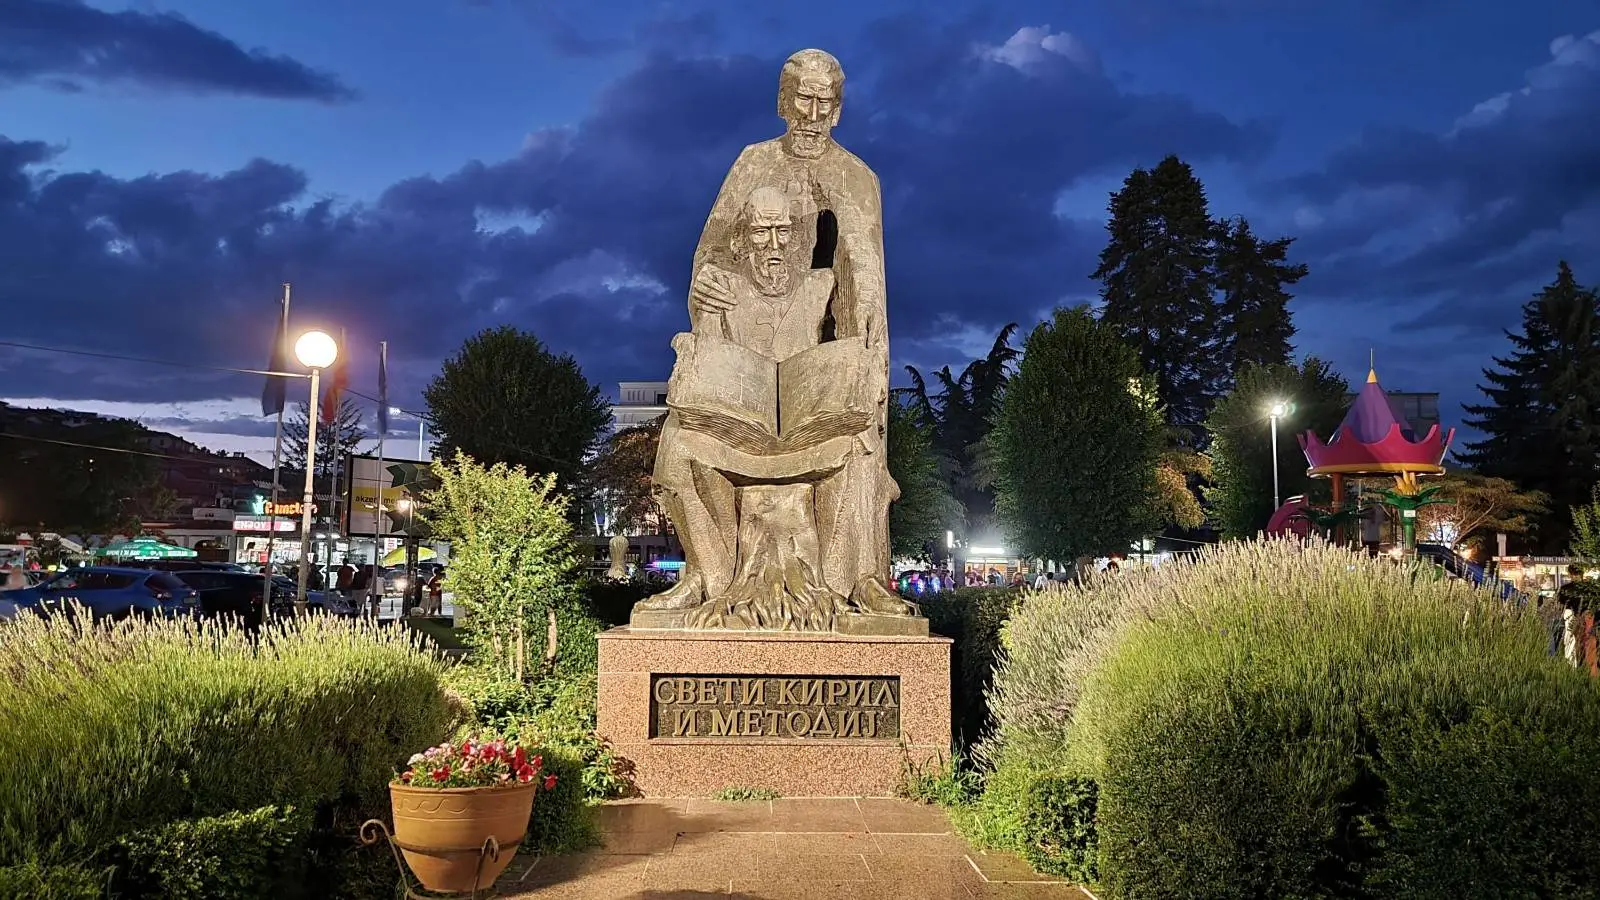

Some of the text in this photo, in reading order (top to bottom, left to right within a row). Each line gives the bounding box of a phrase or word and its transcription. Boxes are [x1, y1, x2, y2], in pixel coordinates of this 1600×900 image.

[655, 678, 898, 708] СВЕТИ КИРИЛ
[672, 708, 878, 739] И МЕТОДИЈ
